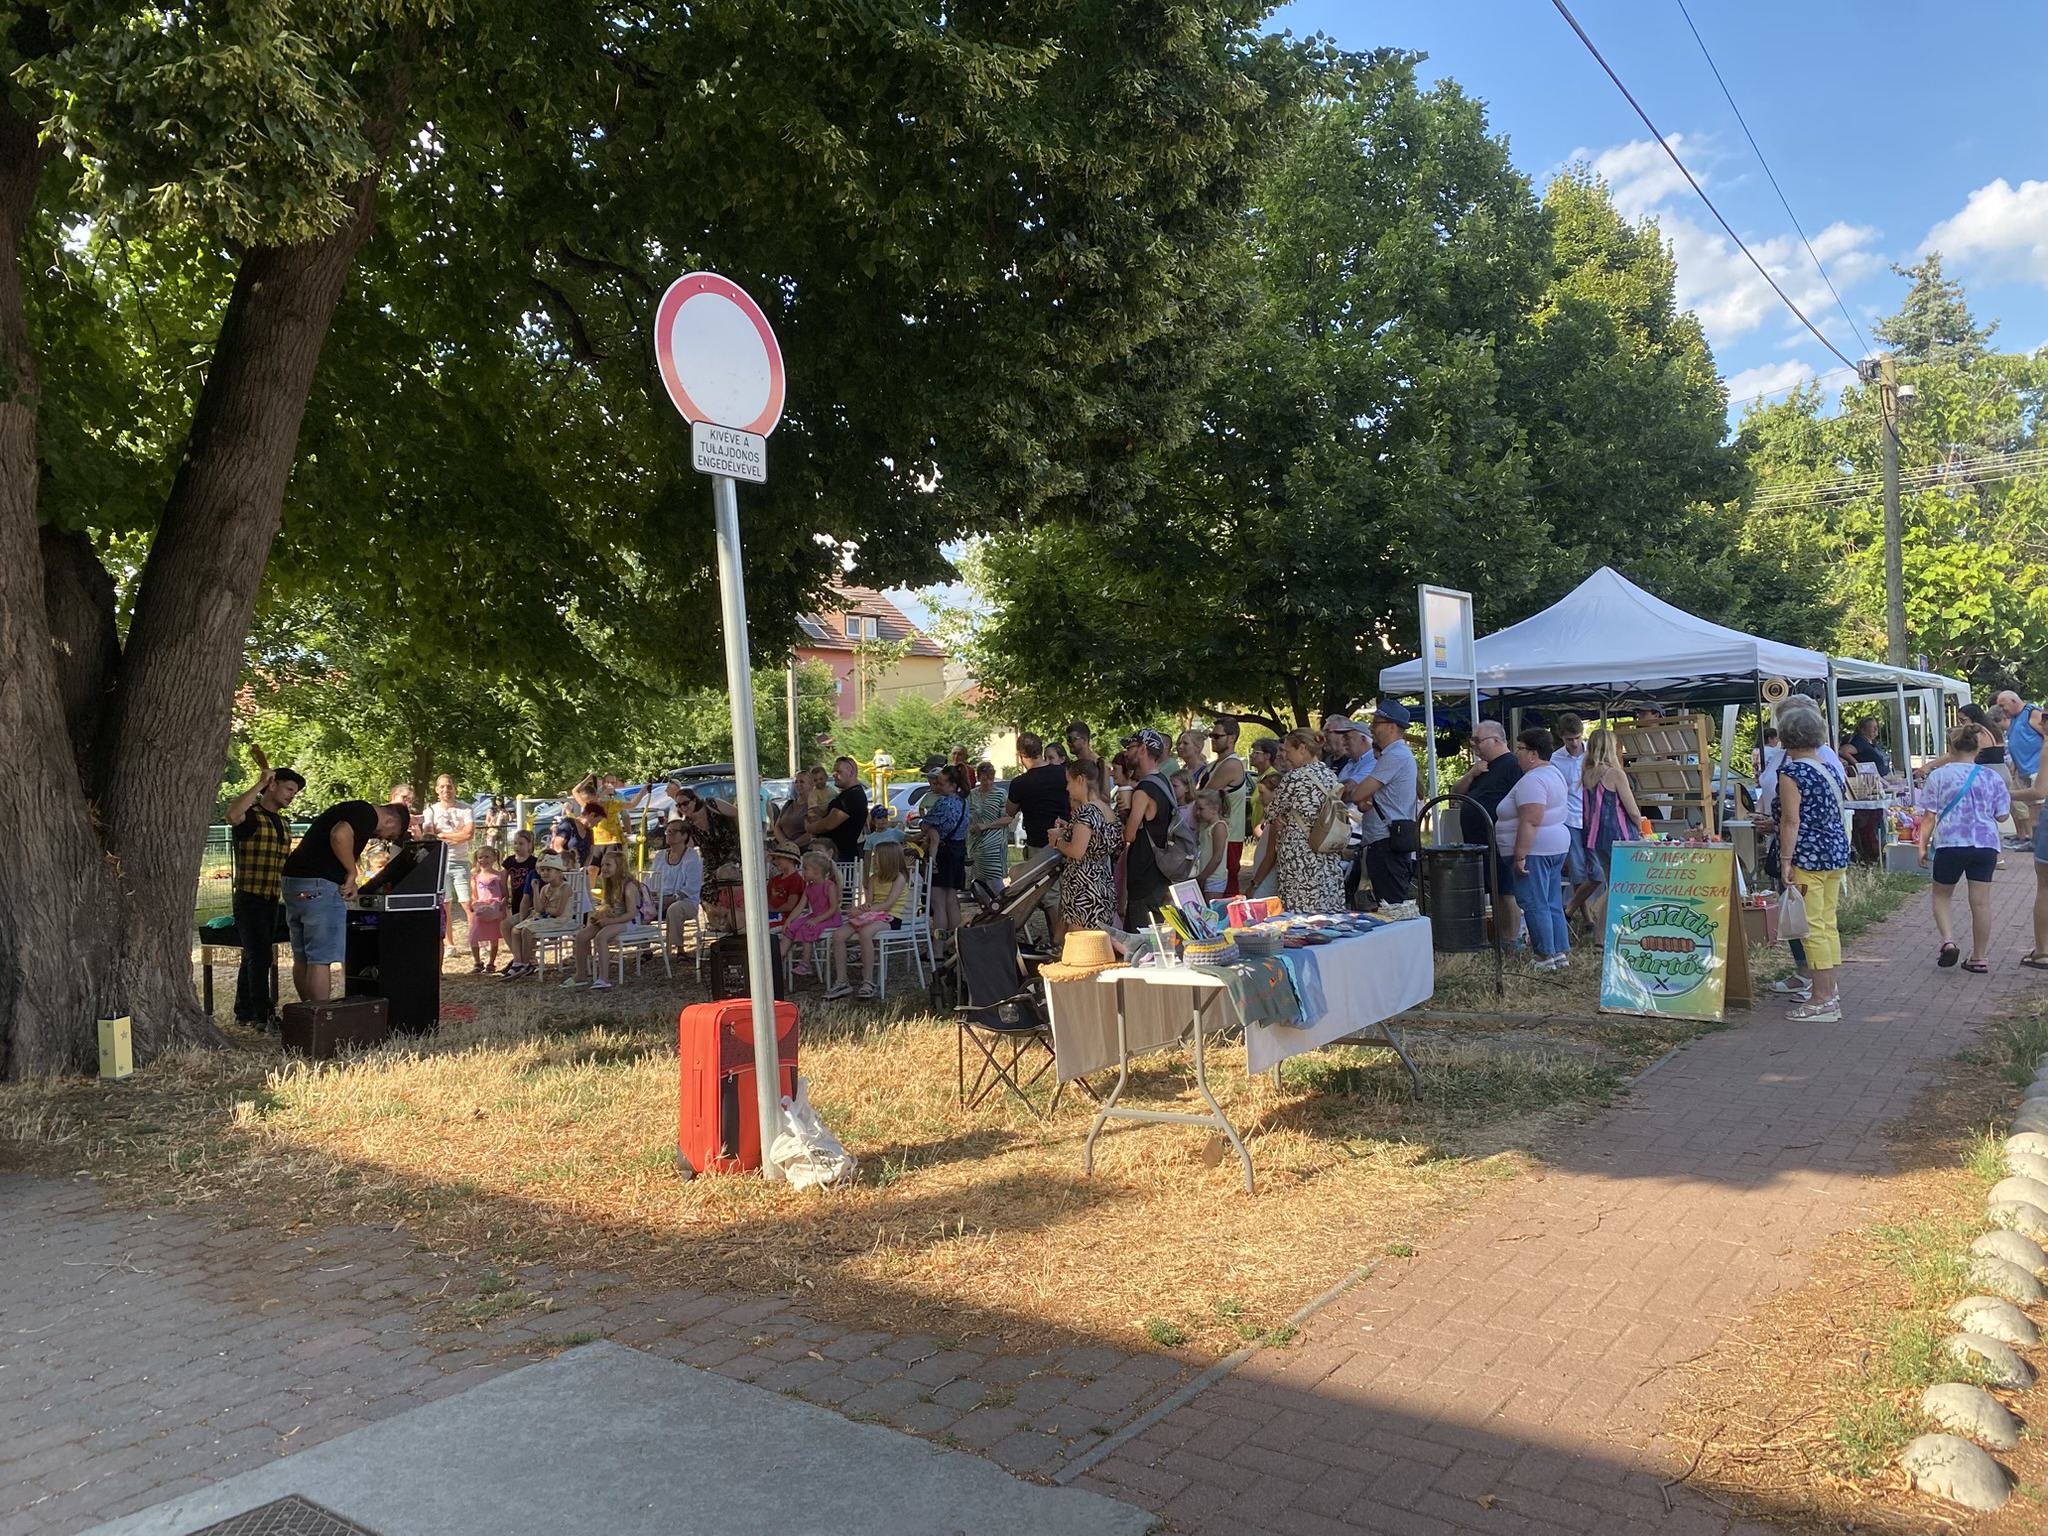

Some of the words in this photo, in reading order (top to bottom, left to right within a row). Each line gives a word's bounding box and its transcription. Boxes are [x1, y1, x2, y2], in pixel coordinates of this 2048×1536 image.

[710, 429, 741, 446] KIVÉVE
[743, 437, 750, 447] A
[700, 441, 760, 463] TULAJDONOS
[698, 455, 762, 477] ENGEDÉLYÉVEL
[1646, 866, 1697, 880] ÍZLETES
